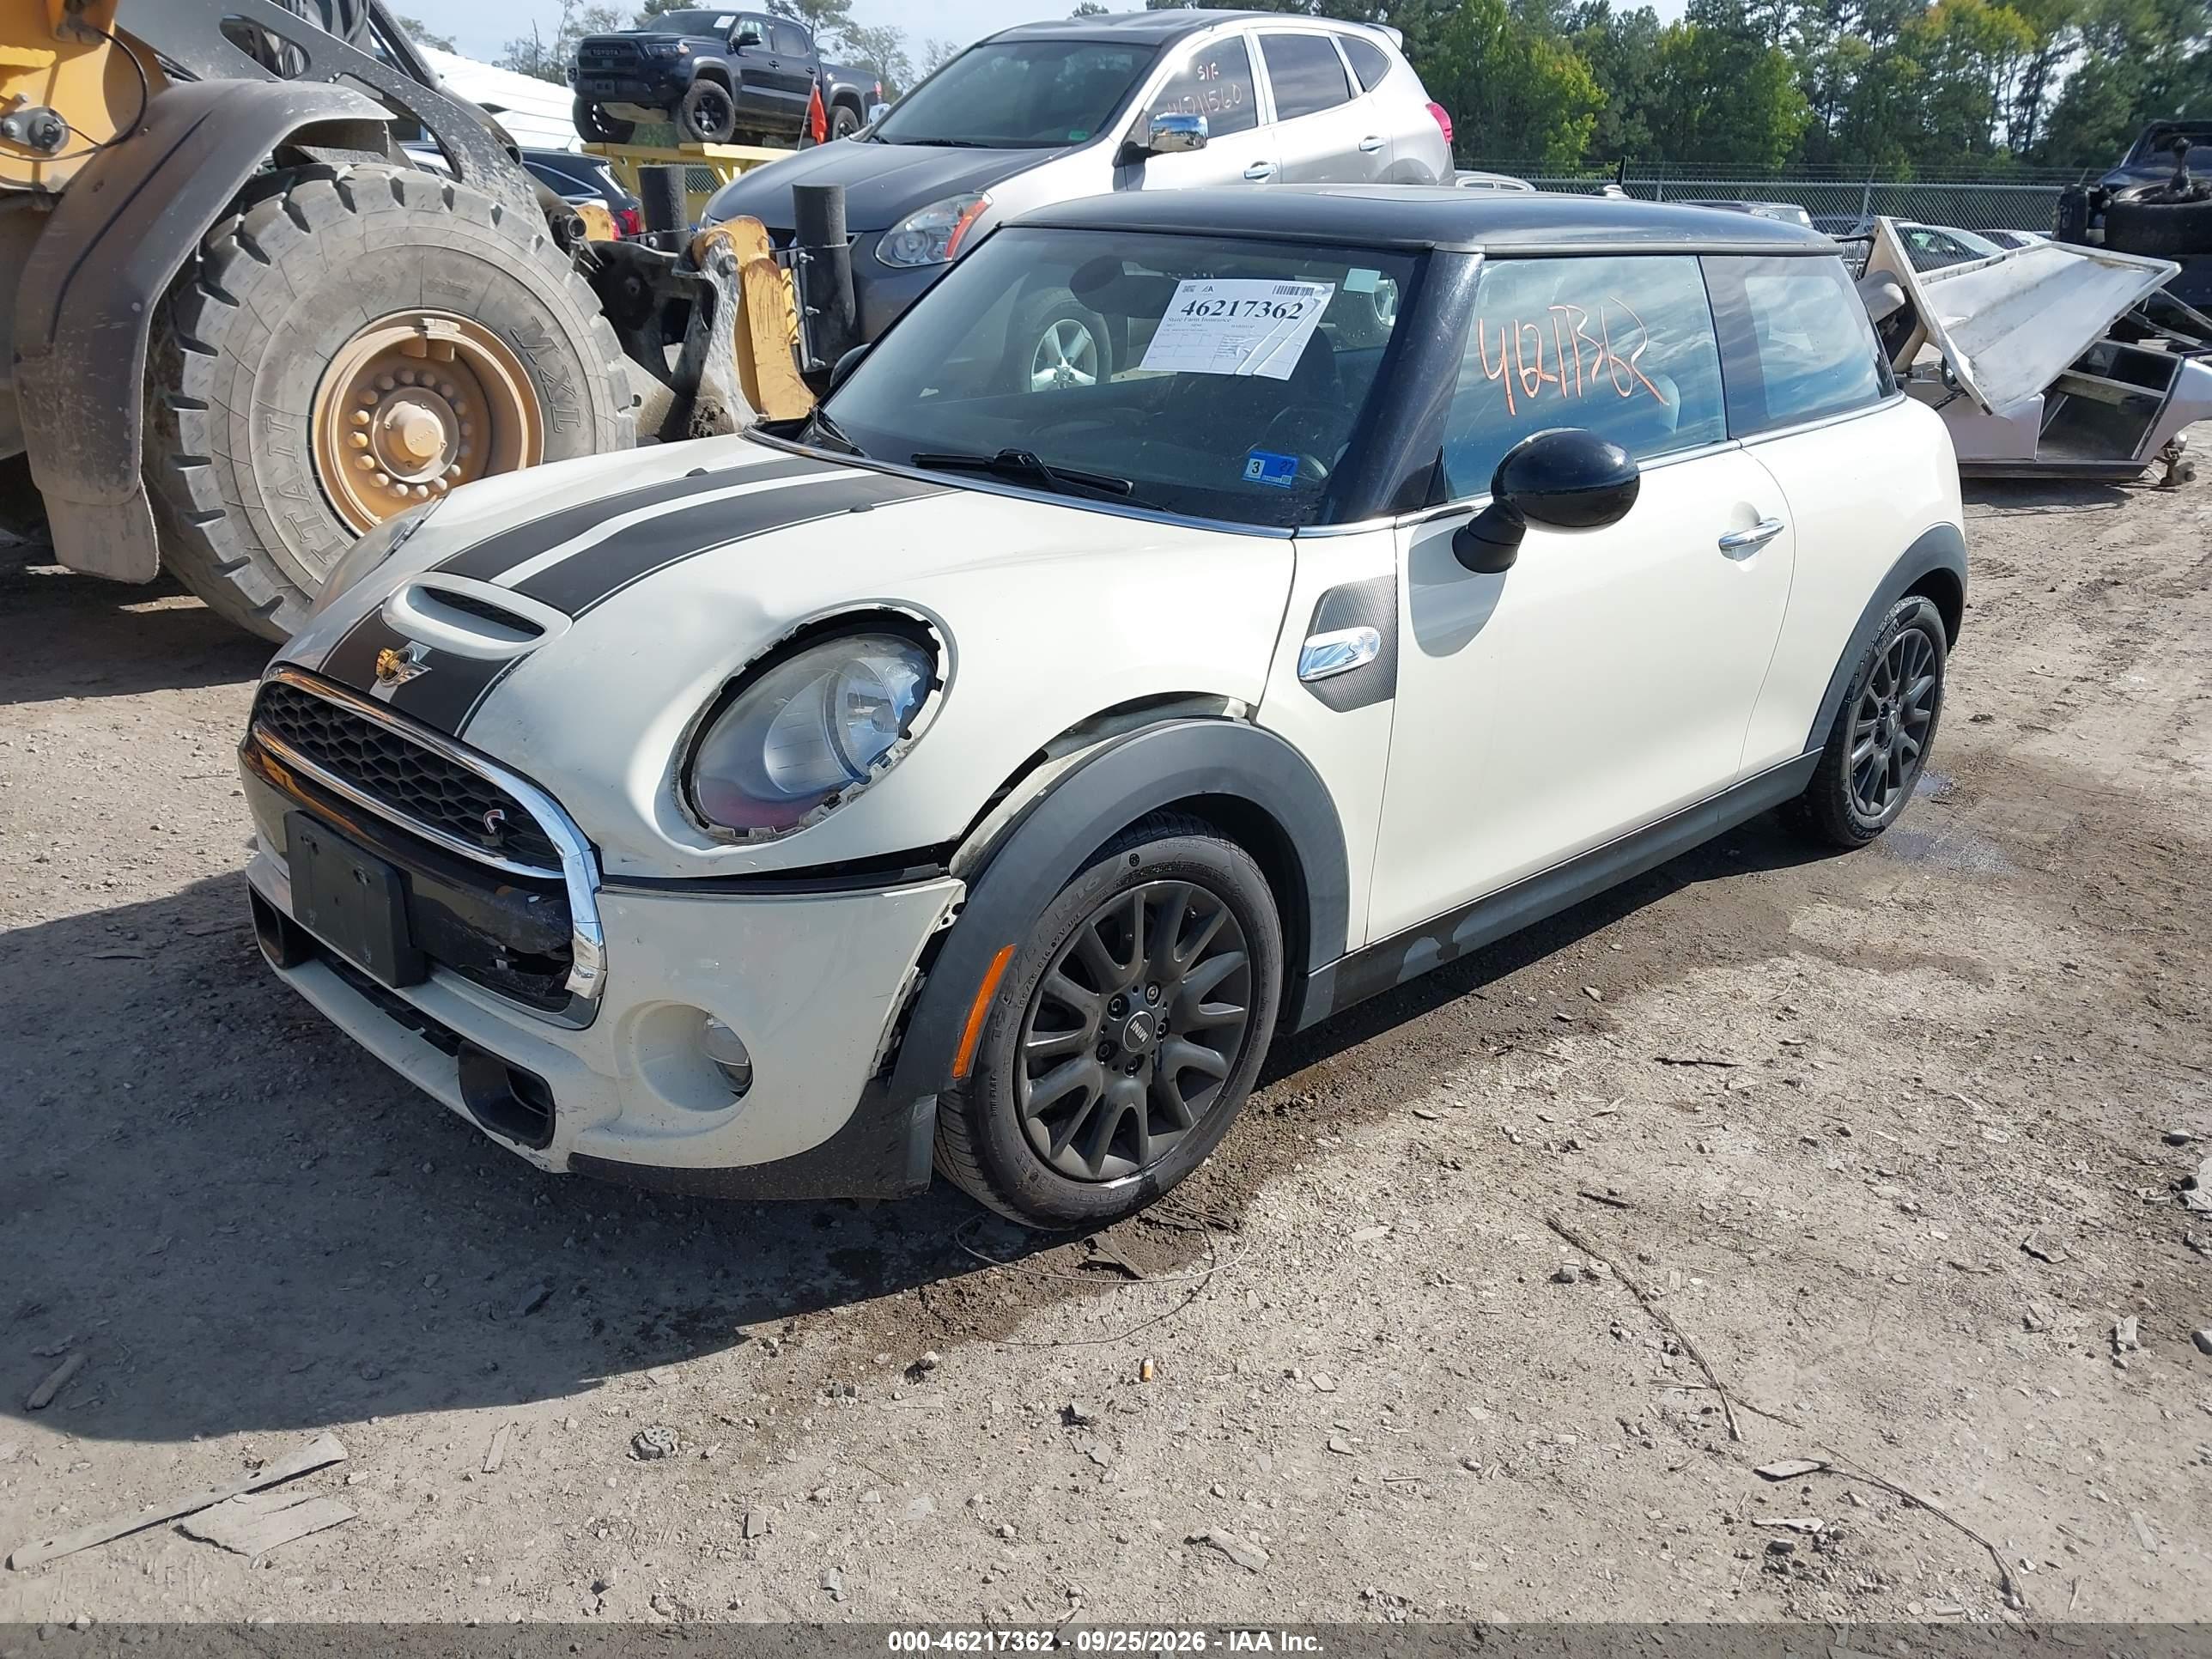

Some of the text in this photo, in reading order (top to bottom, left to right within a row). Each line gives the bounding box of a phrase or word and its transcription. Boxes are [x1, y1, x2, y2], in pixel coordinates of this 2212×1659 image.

[1180, 299, 1304, 320] 46217362
[1251, 460, 1261, 474] 3
[263, 414, 356, 570] ITAN
[1130, 1020, 1149, 1042] MINI
